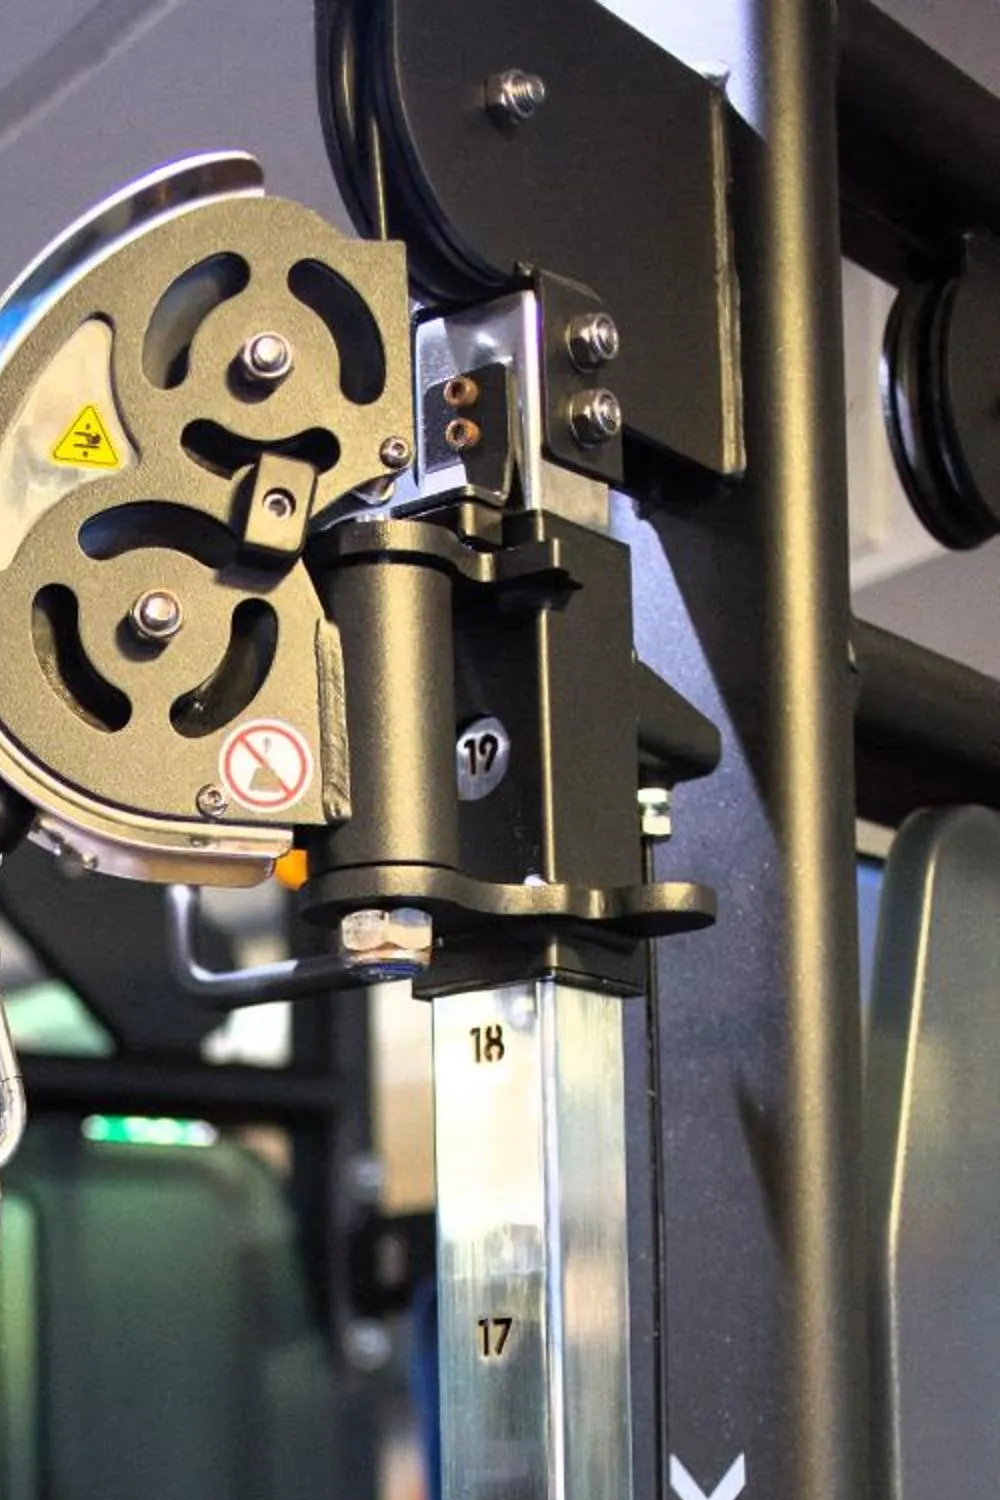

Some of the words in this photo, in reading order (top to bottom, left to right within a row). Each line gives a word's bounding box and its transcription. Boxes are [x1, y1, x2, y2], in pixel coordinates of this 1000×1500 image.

[463, 733, 499, 776] 19
[470, 1024, 505, 1062] 18
[478, 1317, 513, 1356] 17
